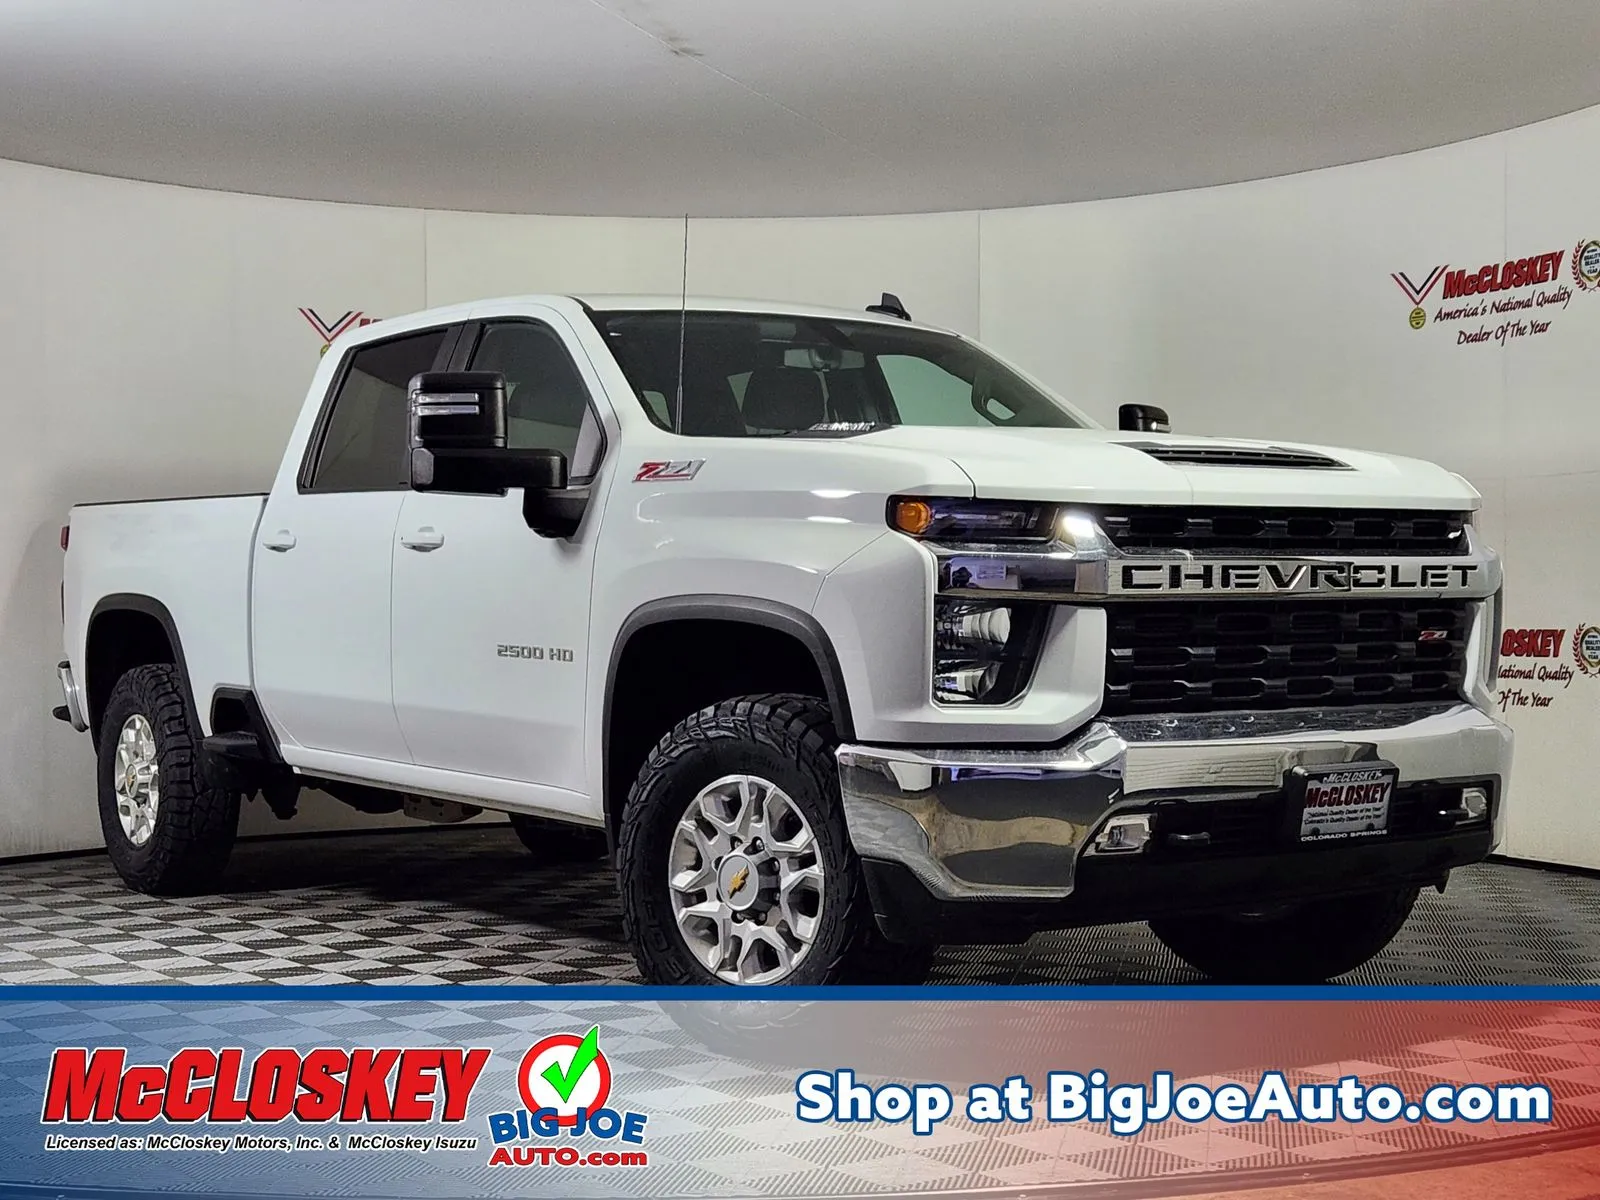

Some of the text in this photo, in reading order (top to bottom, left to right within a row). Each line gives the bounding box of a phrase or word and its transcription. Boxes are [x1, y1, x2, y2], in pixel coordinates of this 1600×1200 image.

[1443, 250, 1565, 299] McCLOSKEY
[1433, 299, 1488, 323] America's
[1490, 290, 1535, 315] National
[1536, 285, 1573, 310] Quality
[1457, 318, 1553, 347] Dealer Of The Year
[632, 458, 707, 484] Z71
[1121, 563, 1480, 591] CHEVROLET
[497, 644, 574, 663] 2500 HD
[1500, 629, 1566, 658] OSKEY
[1538, 663, 1574, 689] Quality
[1512, 689, 1529, 707] The
[1531, 692, 1553, 708] Year
[1305, 782, 1391, 808] McCLOSKEY
[1301, 829, 1388, 842] COLORADO SPRINGS
